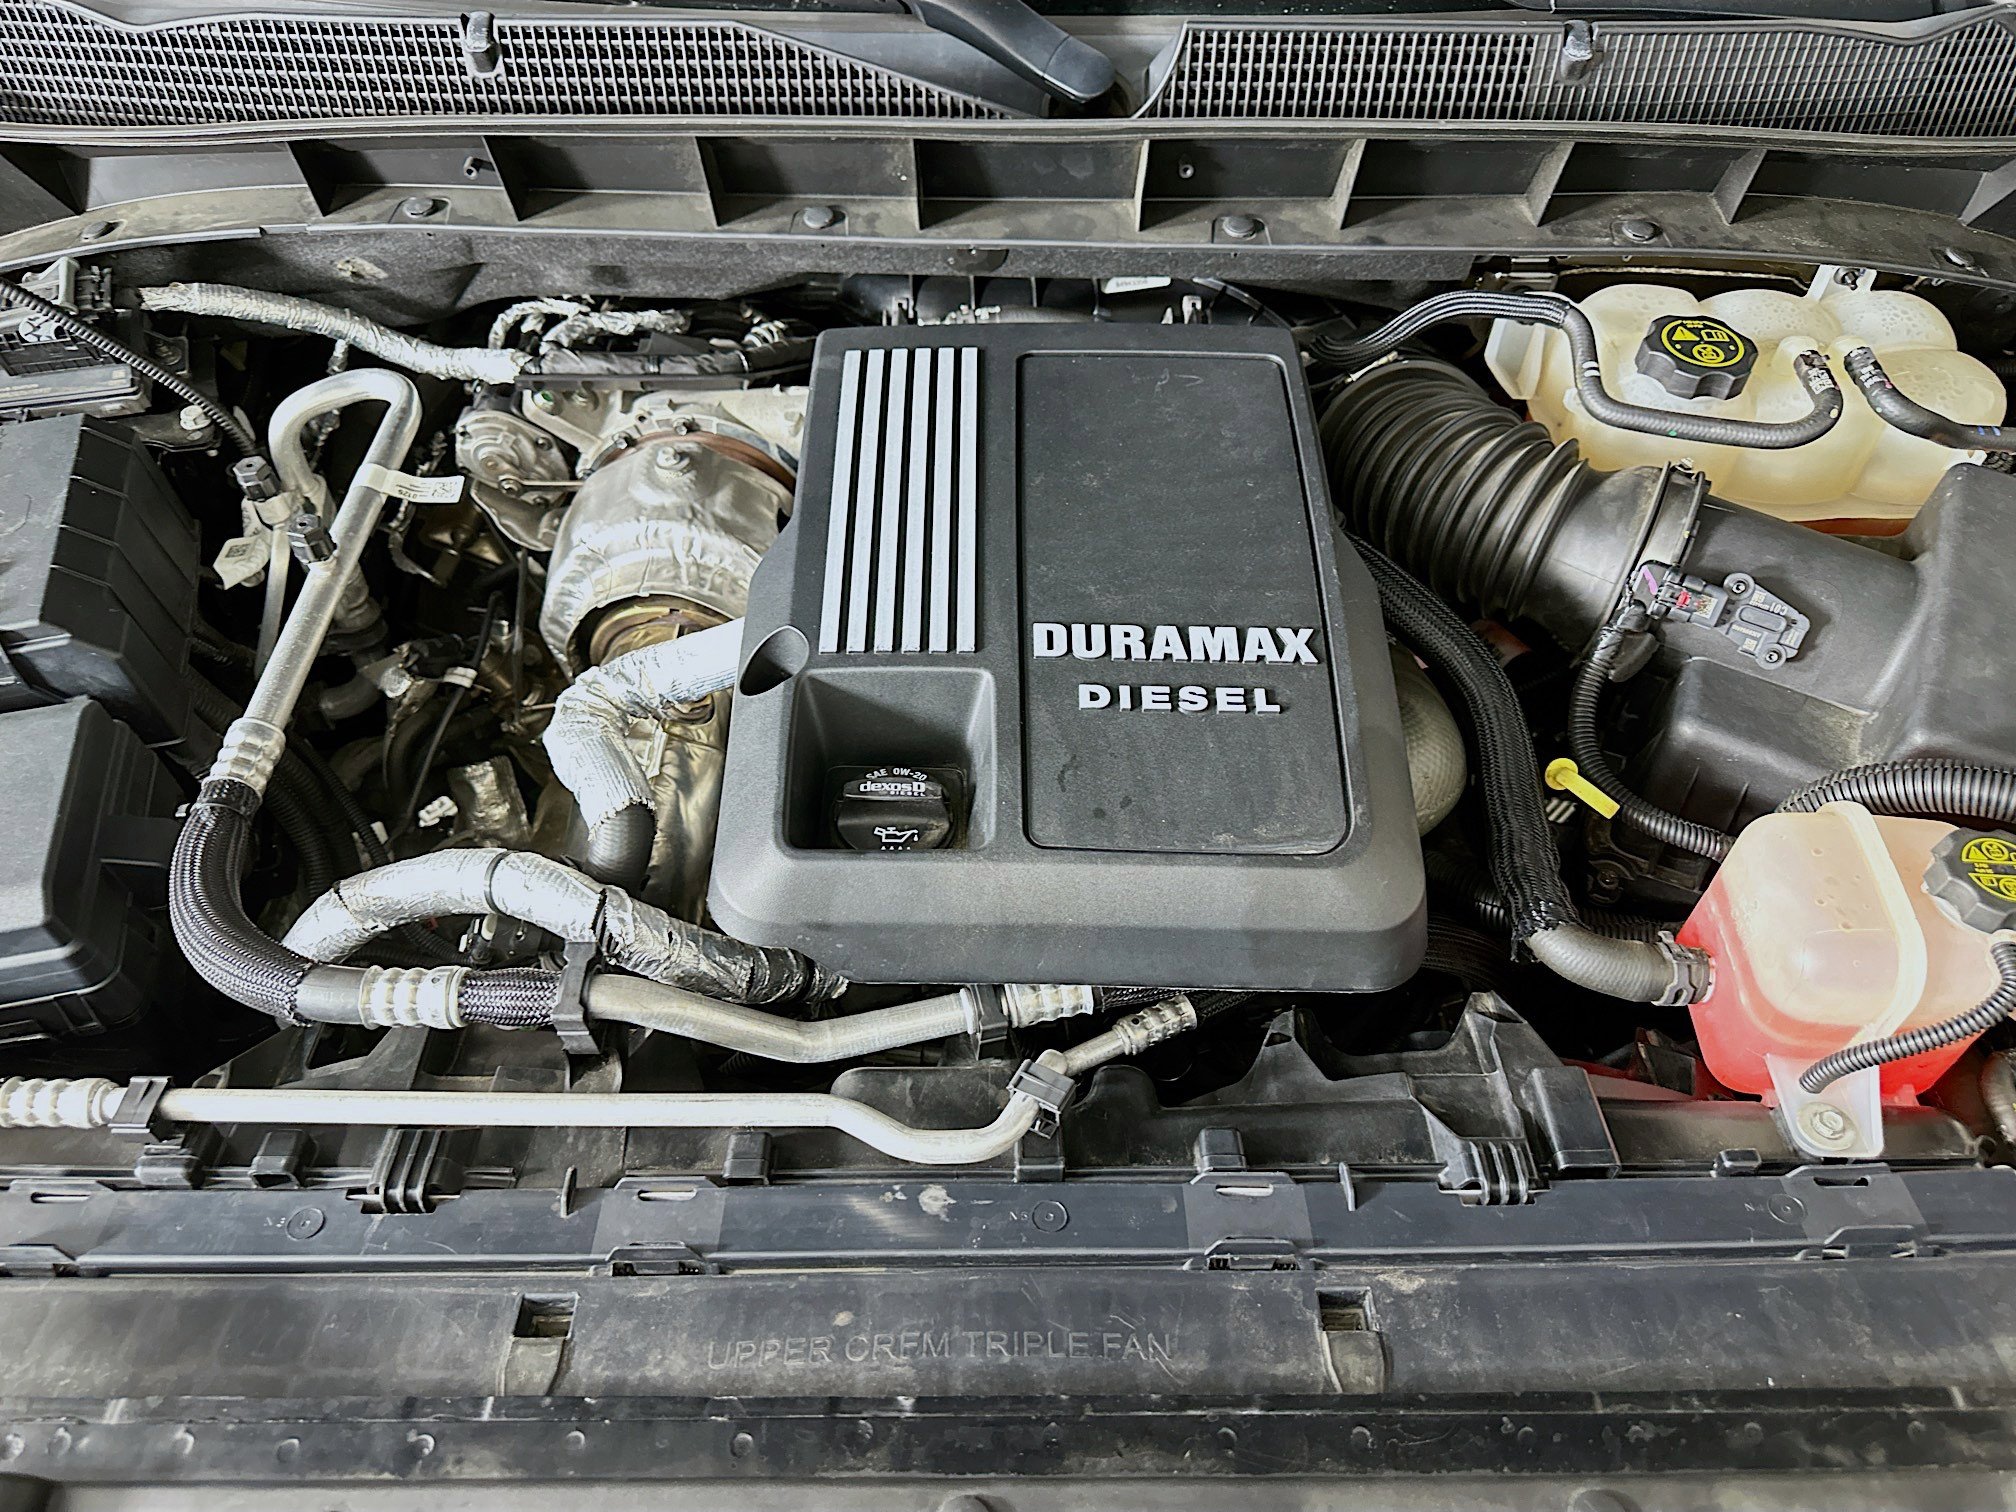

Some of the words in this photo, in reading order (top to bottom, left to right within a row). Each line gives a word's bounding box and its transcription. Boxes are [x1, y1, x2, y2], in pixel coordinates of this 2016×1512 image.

[1033, 622, 1319, 665] DURAMAX
[1078, 683, 1282, 715] DIESEL
[865, 768, 889, 780] SAE
[892, 767, 928, 782] 0W-20
[707, 1335, 834, 1371] UPPER
[962, 1331, 1092, 1359] TRIPLE
[1102, 1332, 1173, 1362] FAN
